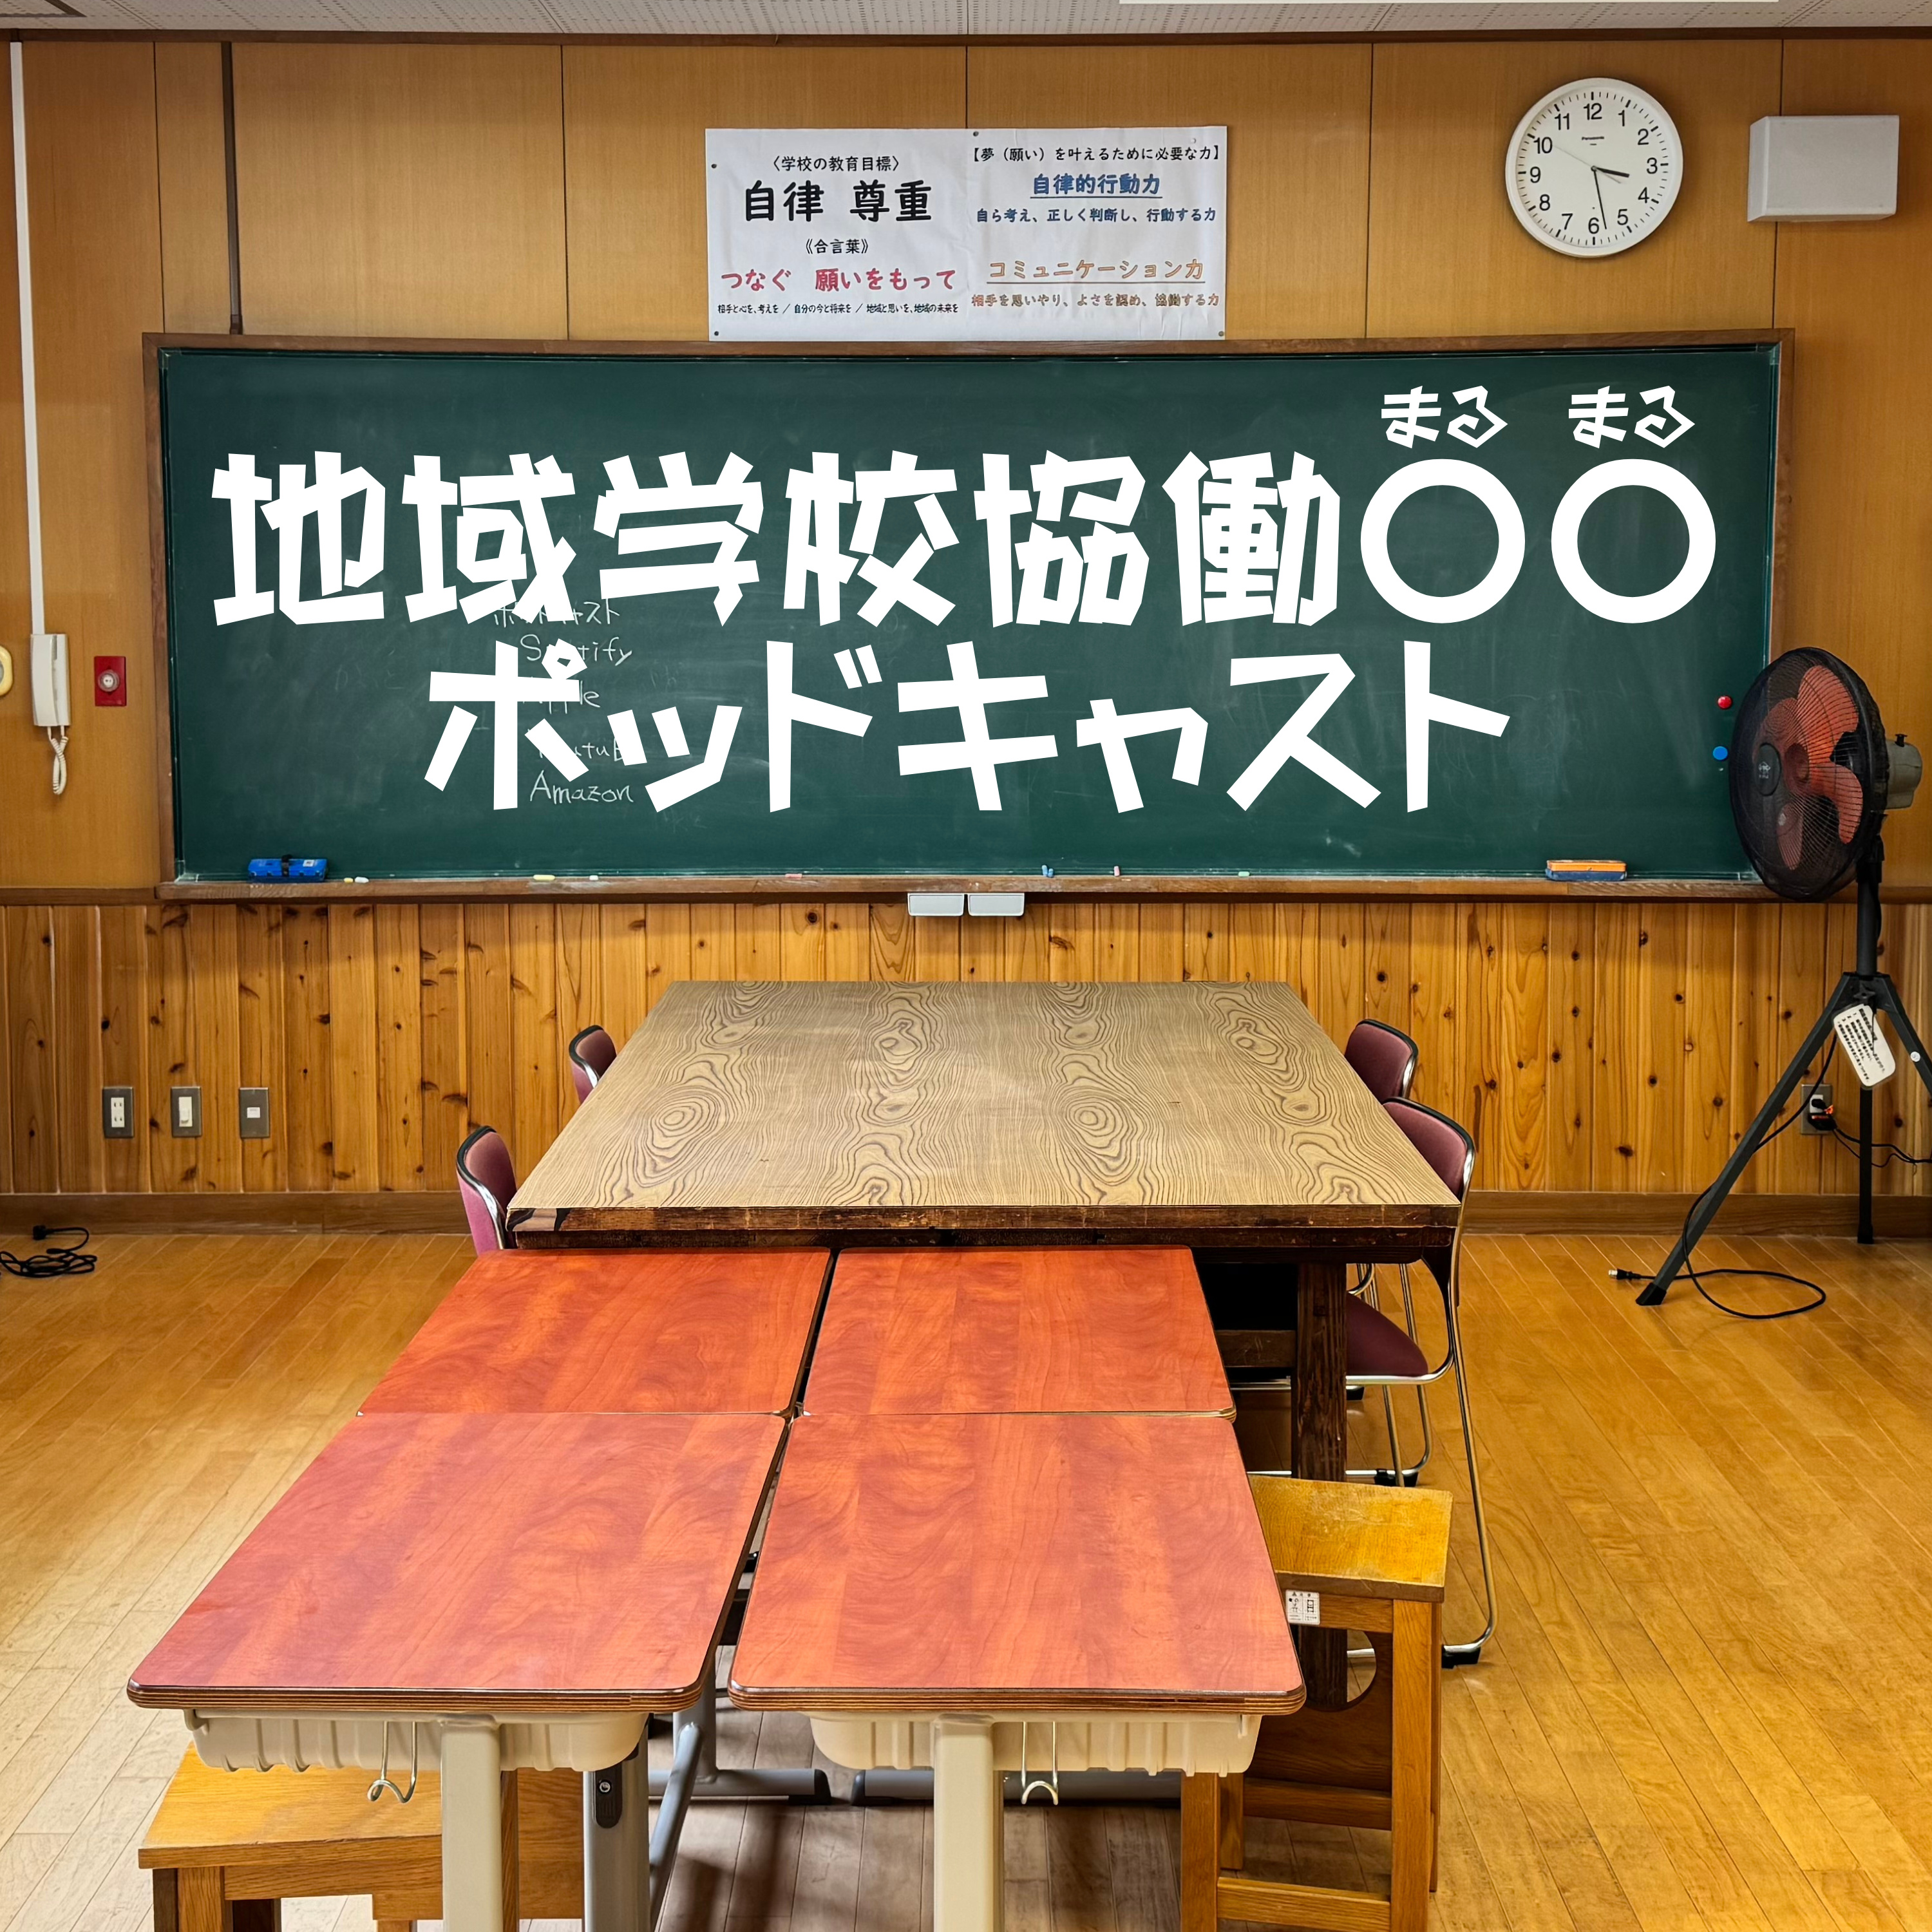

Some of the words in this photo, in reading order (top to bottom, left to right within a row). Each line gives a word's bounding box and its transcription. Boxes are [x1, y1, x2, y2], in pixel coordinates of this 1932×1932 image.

[1583, 102, 1603, 120] 12
[1617, 109, 1626, 127] 1
[1554, 113, 1570, 131] 11
[1533, 136, 1553, 154] 10
[1637, 128, 1649, 146] 2
[1529, 166, 1542, 184] 9
[1645, 157, 1658, 175] 3
[1033, 173, 1160, 194] 自律的行動力
[745, 180, 824, 222] 自律
[849, 179, 932, 222] 尊重
[1539, 194, 1551, 211] 8
[1638, 187, 1650, 204] 4
[1560, 213, 1573, 230] 7
[1616, 208, 1629, 225] 5
[1587, 218, 1600, 234] 6
[805, 238, 869, 254] 《合言葉》
[989, 259, 1204, 279] コミュニケーション力
[721, 268, 791, 291] つなぐ
[815, 268, 956, 292] 願いをもって
[520, 634, 632, 666] Stify
[529, 770, 634, 804] Amazon
